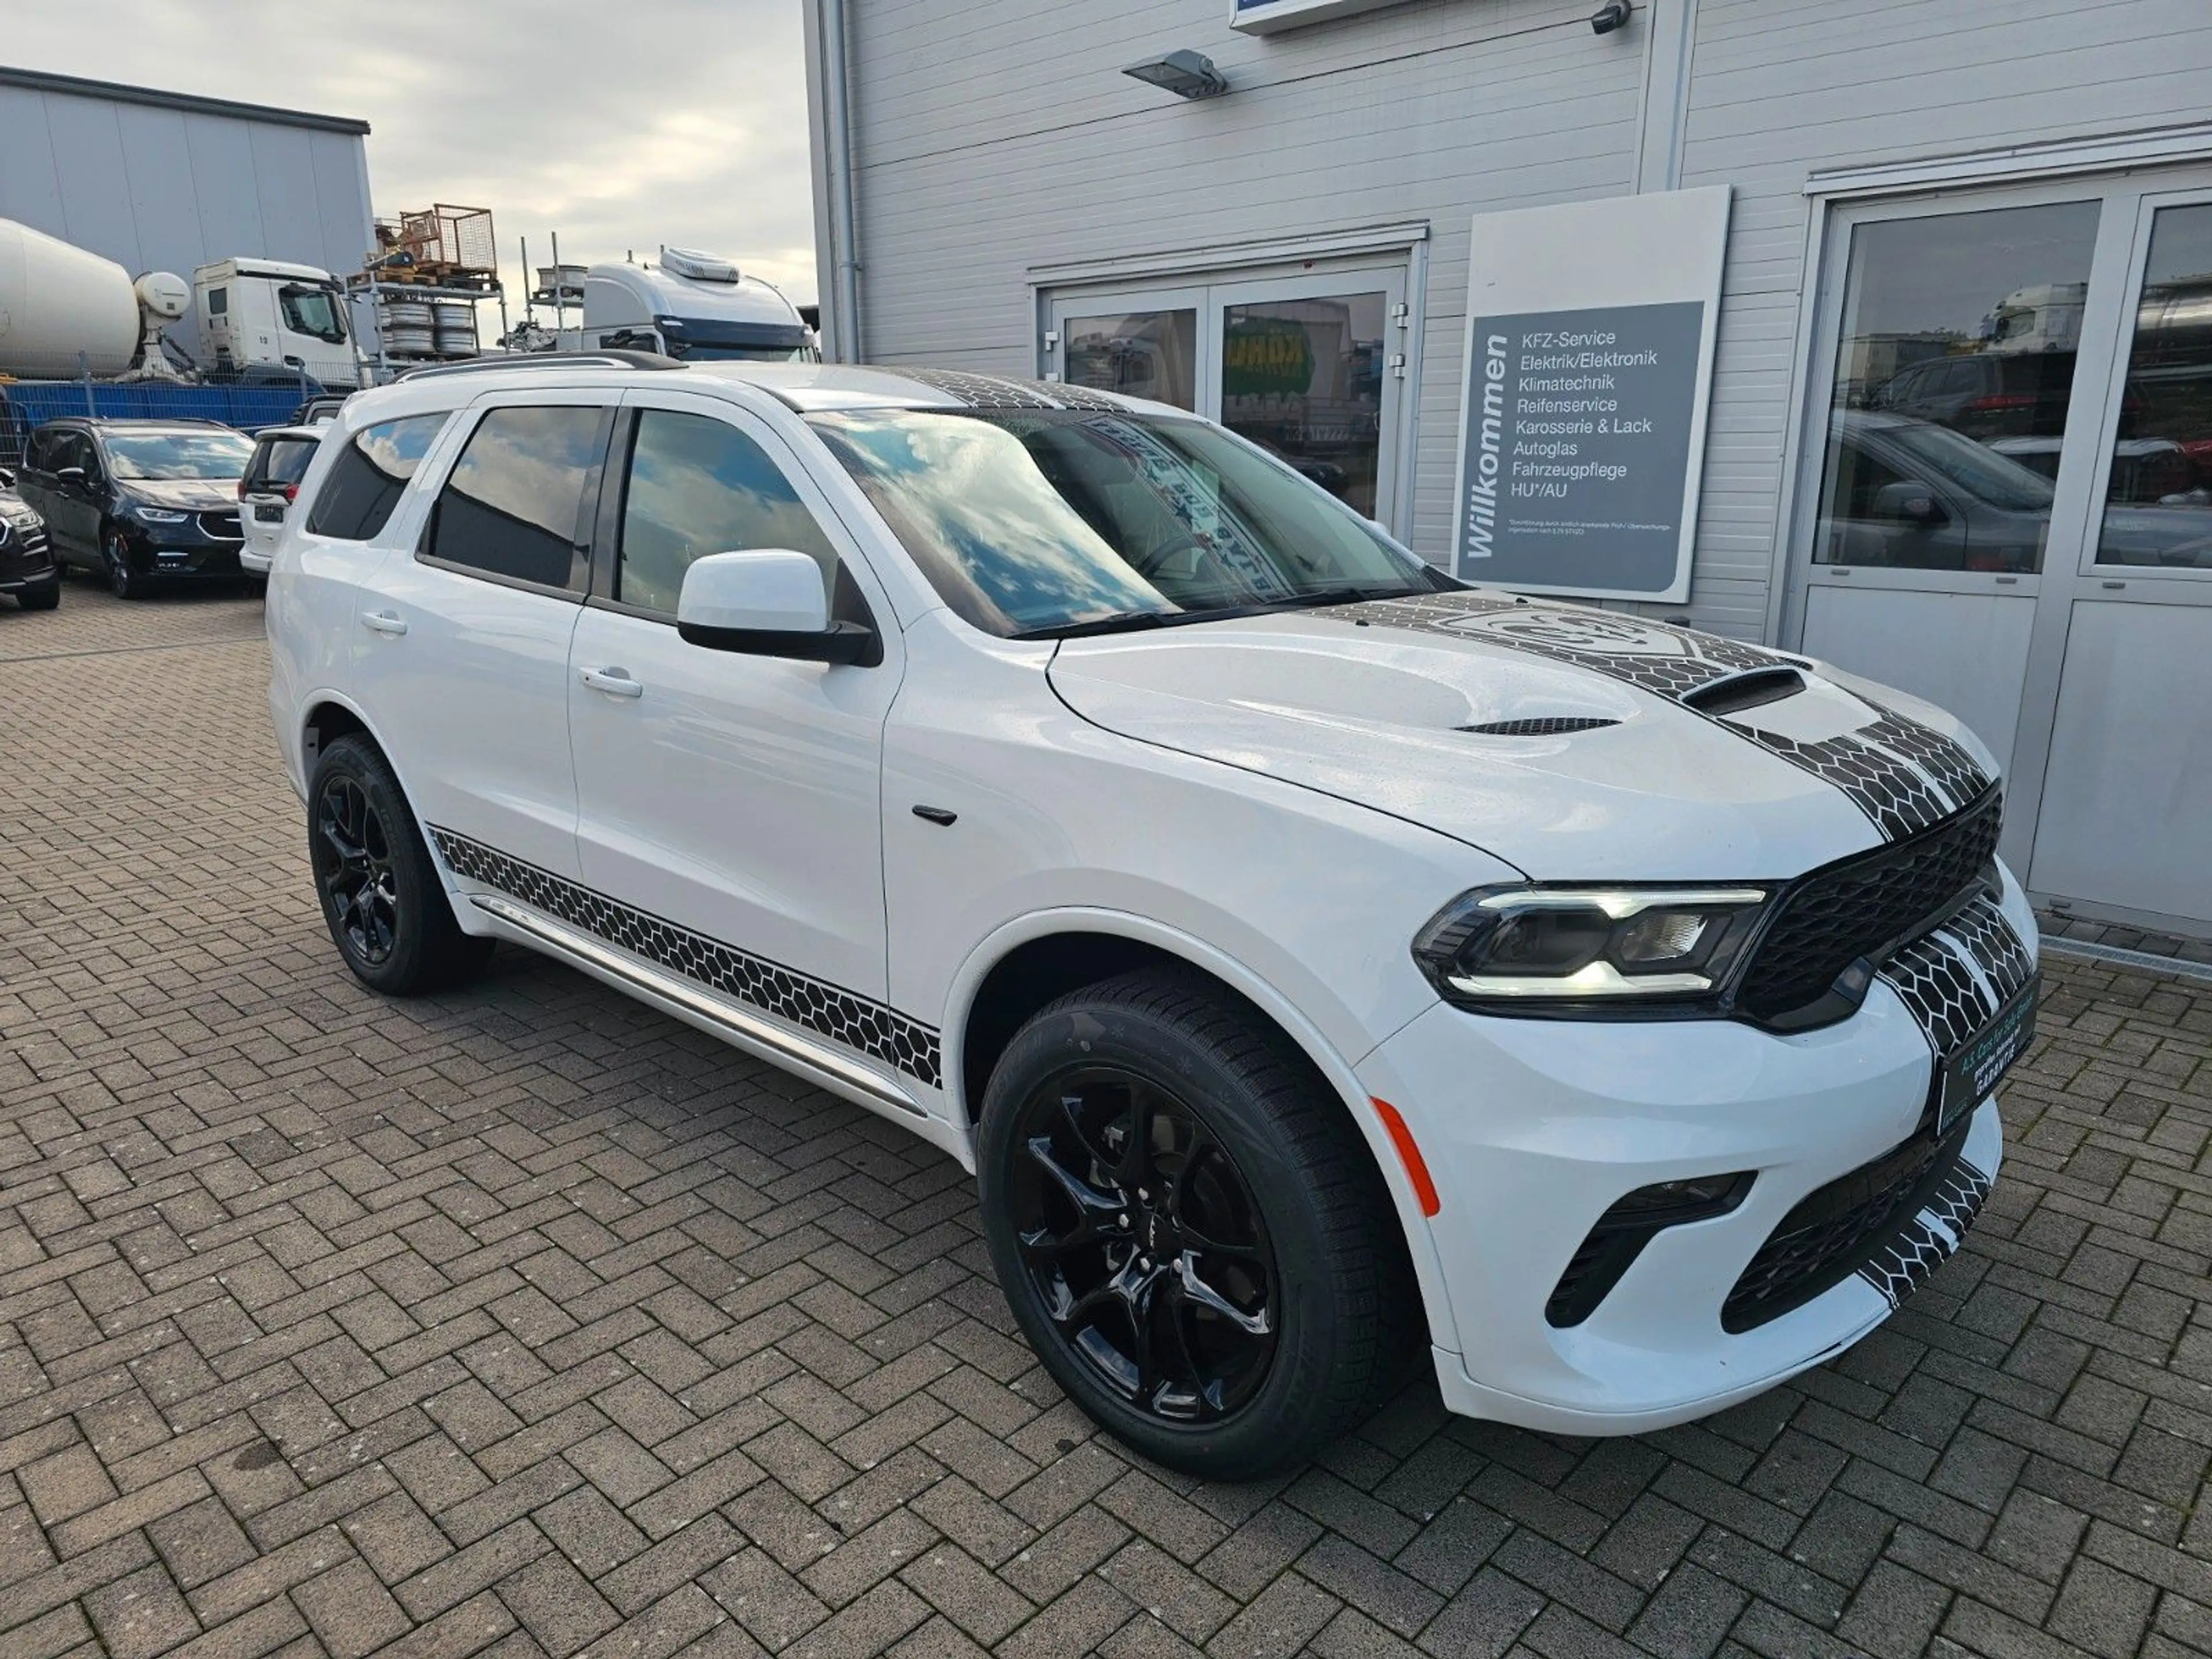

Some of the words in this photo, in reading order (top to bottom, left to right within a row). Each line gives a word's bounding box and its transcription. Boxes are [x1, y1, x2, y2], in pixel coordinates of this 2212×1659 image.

[1522, 330, 1616, 349] KFZ-Service
[1520, 350, 1658, 370] Elektrik/Elektronik
[1518, 374, 1615, 392] Klimatechnik
[1517, 396, 1618, 414] Reifenservice
[1516, 419, 1593, 435] Karosserie
[1597, 418, 1609, 434] &
[1613, 418, 1652, 433] Lack
[1467, 334, 1508, 559] Willkommen
[1513, 440, 1578, 459] Autoglas
[1512, 461, 1627, 480] Fahrzeugpflege
